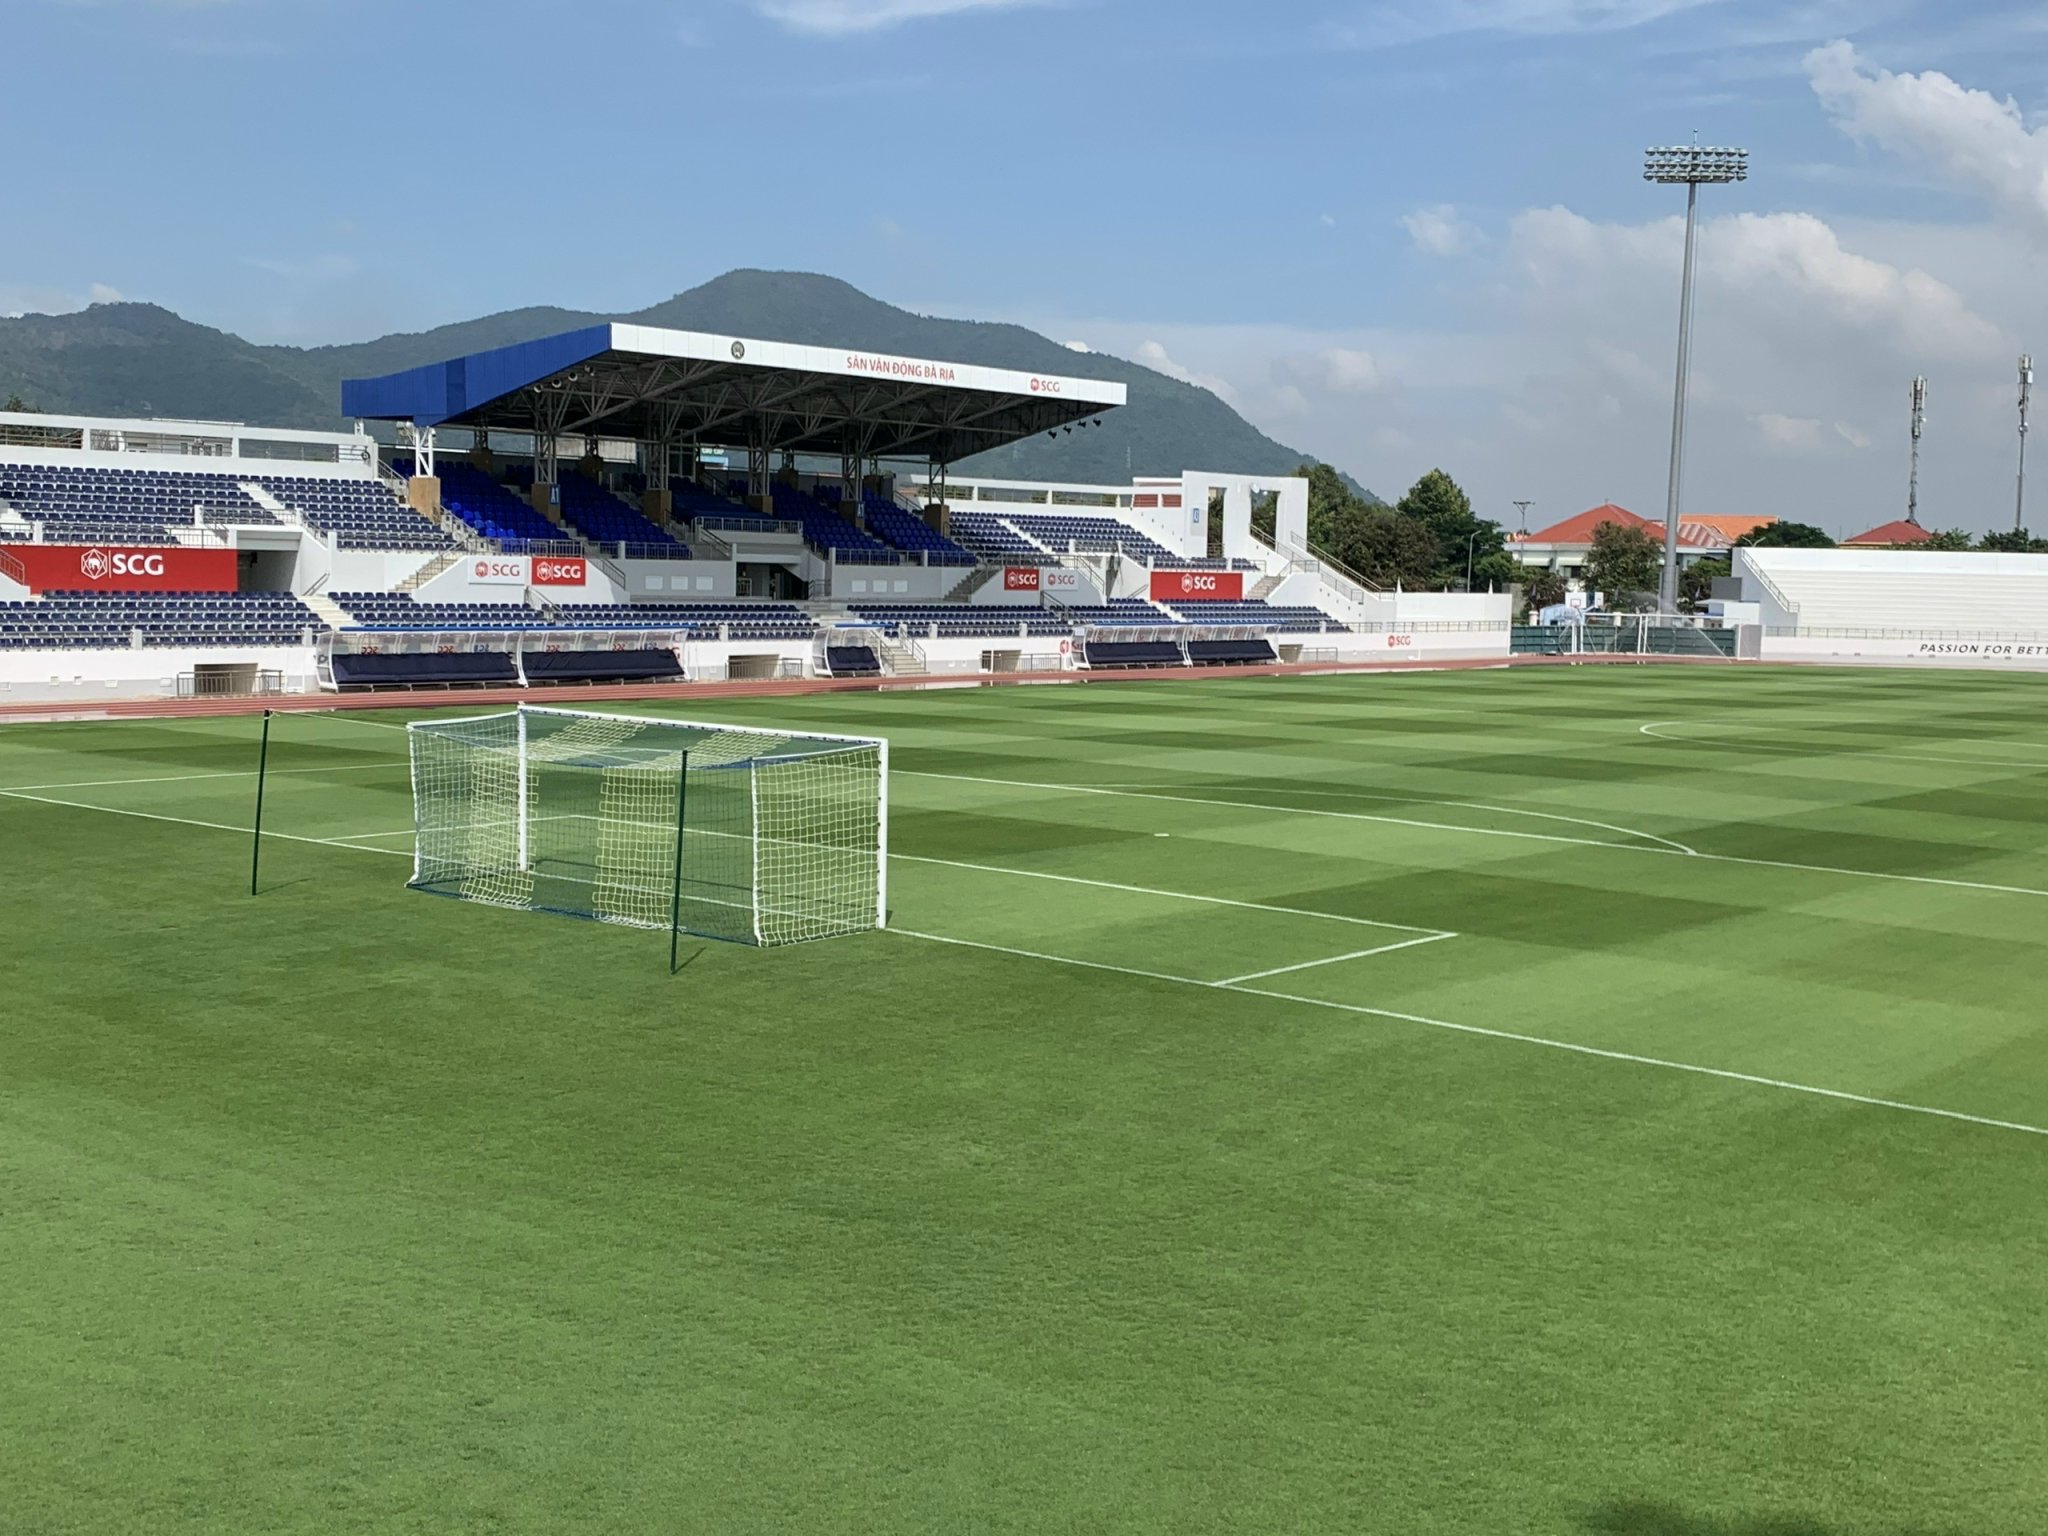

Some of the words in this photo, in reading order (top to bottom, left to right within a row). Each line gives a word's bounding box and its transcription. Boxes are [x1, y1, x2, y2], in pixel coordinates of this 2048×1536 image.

[1041, 380, 1060, 392] SCG
[112, 553, 164, 576] SCG
[492, 564, 520, 577] SCG
[553, 565, 581, 578] SCG
[1018, 574, 1037, 585] SCG
[1057, 575, 1075, 585] SCG
[1194, 576, 1216, 590] SCG
[1396, 635, 1411, 646] SCG
[1920, 644, 1979, 654] PASSION
[1984, 645, 2012, 654] FOR
